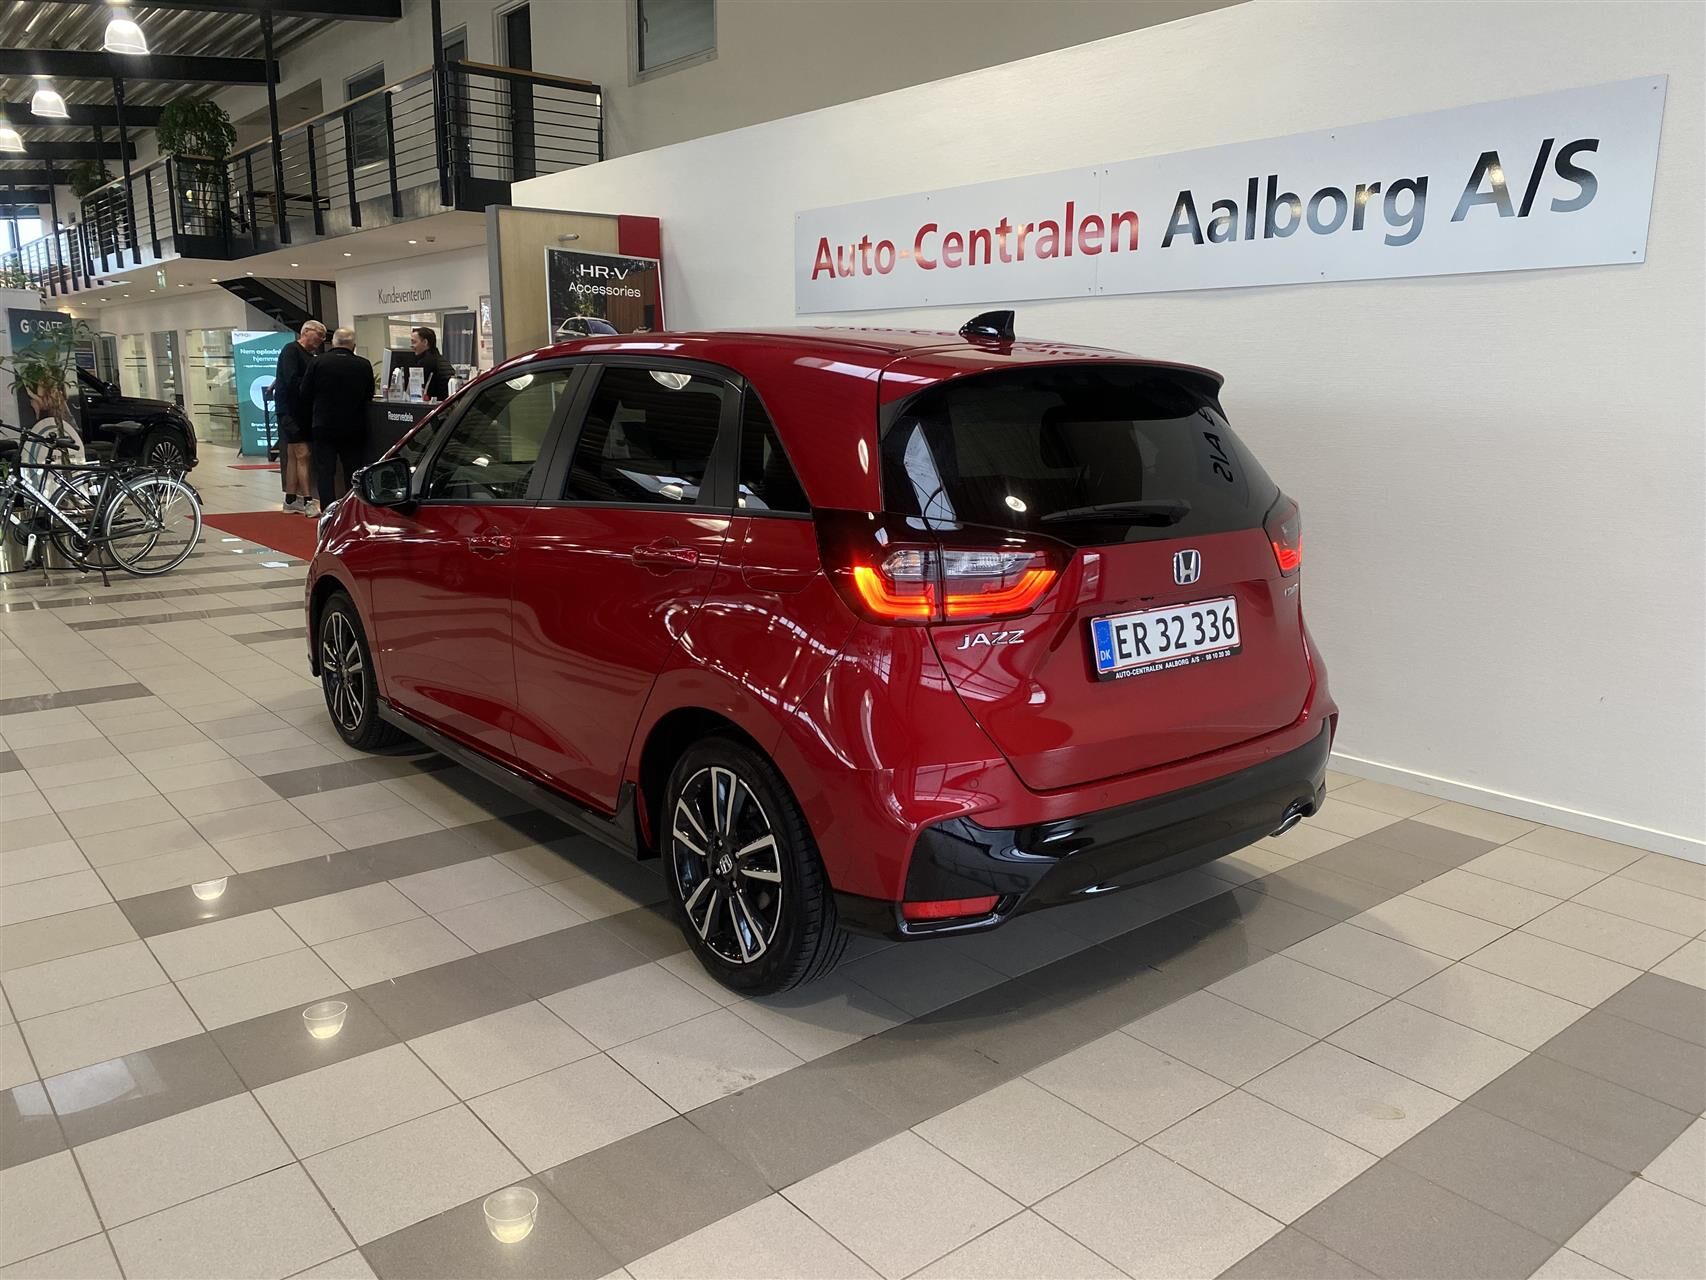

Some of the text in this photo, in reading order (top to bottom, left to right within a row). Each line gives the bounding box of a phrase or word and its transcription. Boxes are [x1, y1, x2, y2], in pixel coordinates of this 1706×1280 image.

[811, 137, 1600, 280] Auto-Centralen Aalborg A/S
[580, 264, 629, 280] HR-V
[377, 286, 432, 305] Kundeventerum
[568, 281, 641, 298] Accessories
[957, 629, 1025, 650] JAZZ
[1100, 605, 1236, 661] DK ER 32 336
[1115, 662, 1163, 679] AUTO-CENTRALEN
[1165, 658, 1189, 669] AALBORG
[1191, 656, 1200, 664] A/S
